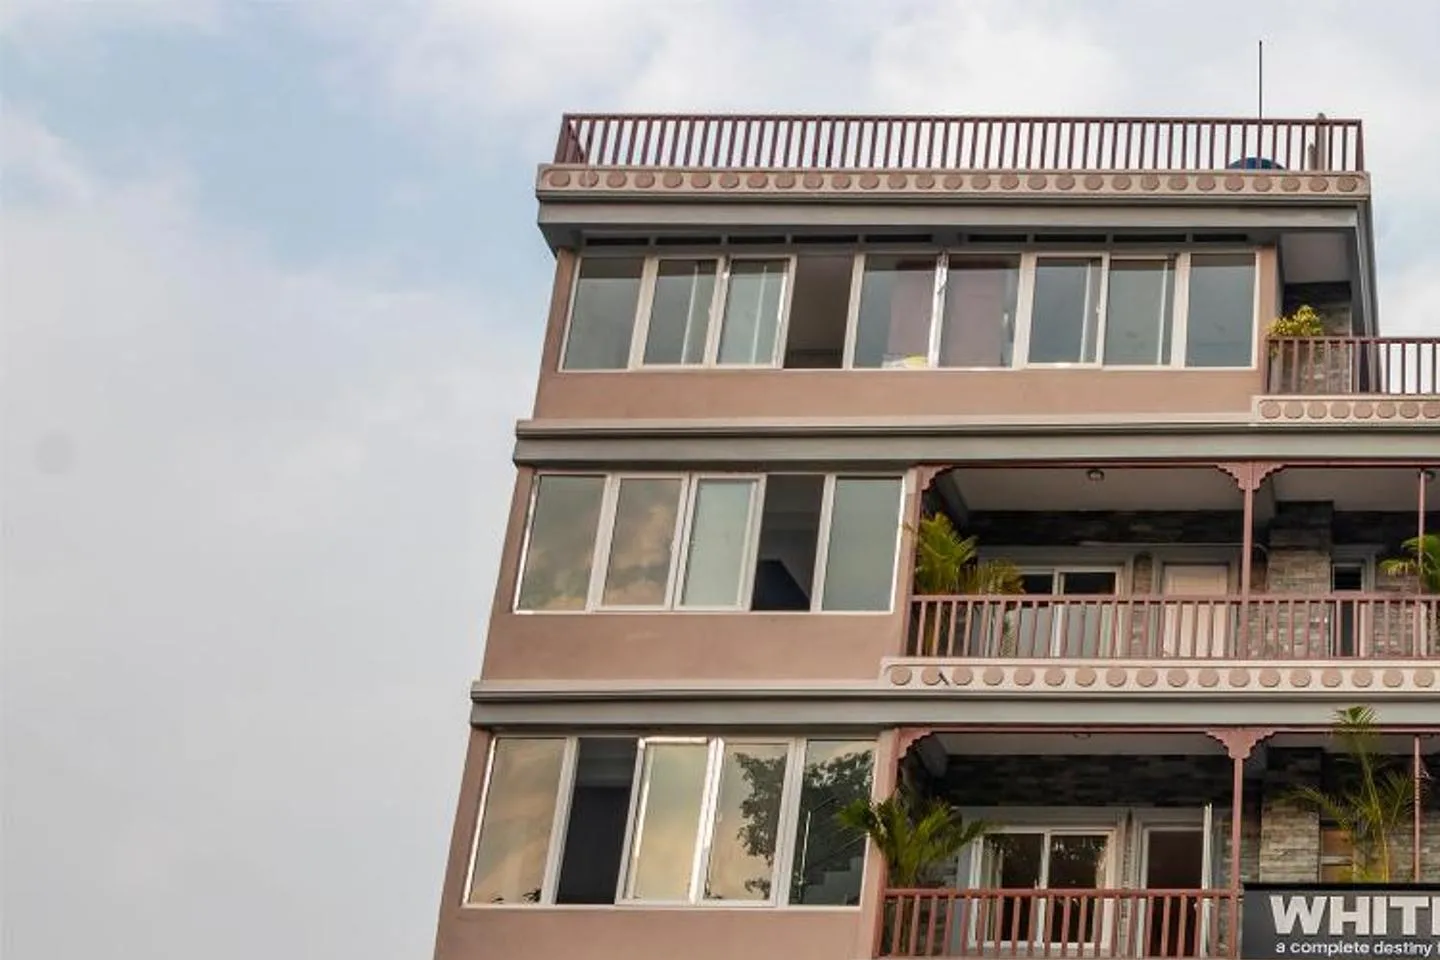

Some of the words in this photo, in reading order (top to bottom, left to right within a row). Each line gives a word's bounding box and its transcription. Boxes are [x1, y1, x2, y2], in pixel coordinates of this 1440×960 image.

[1276, 944, 1286, 953] a
[1290, 941, 1370, 957] complete
[1374, 941, 1433, 957] destiny
